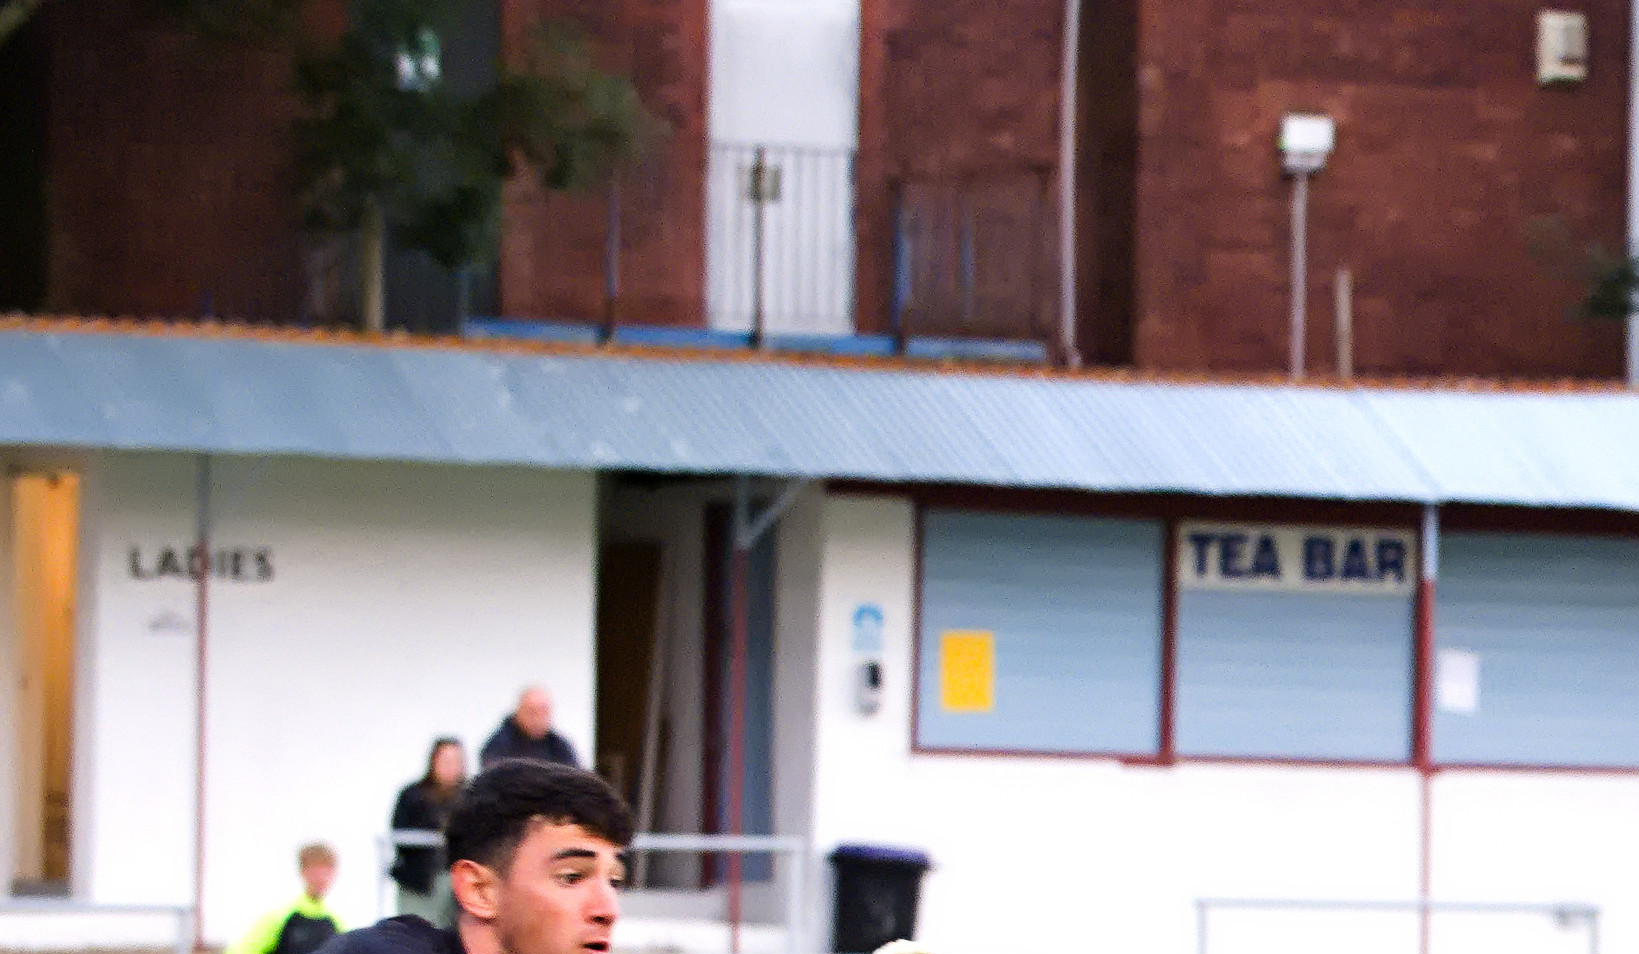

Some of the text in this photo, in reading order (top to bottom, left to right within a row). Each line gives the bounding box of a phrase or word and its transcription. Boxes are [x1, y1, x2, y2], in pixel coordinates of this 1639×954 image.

[129, 545, 275, 582] LADIES
[1187, 532, 1408, 583] TEA BAR
